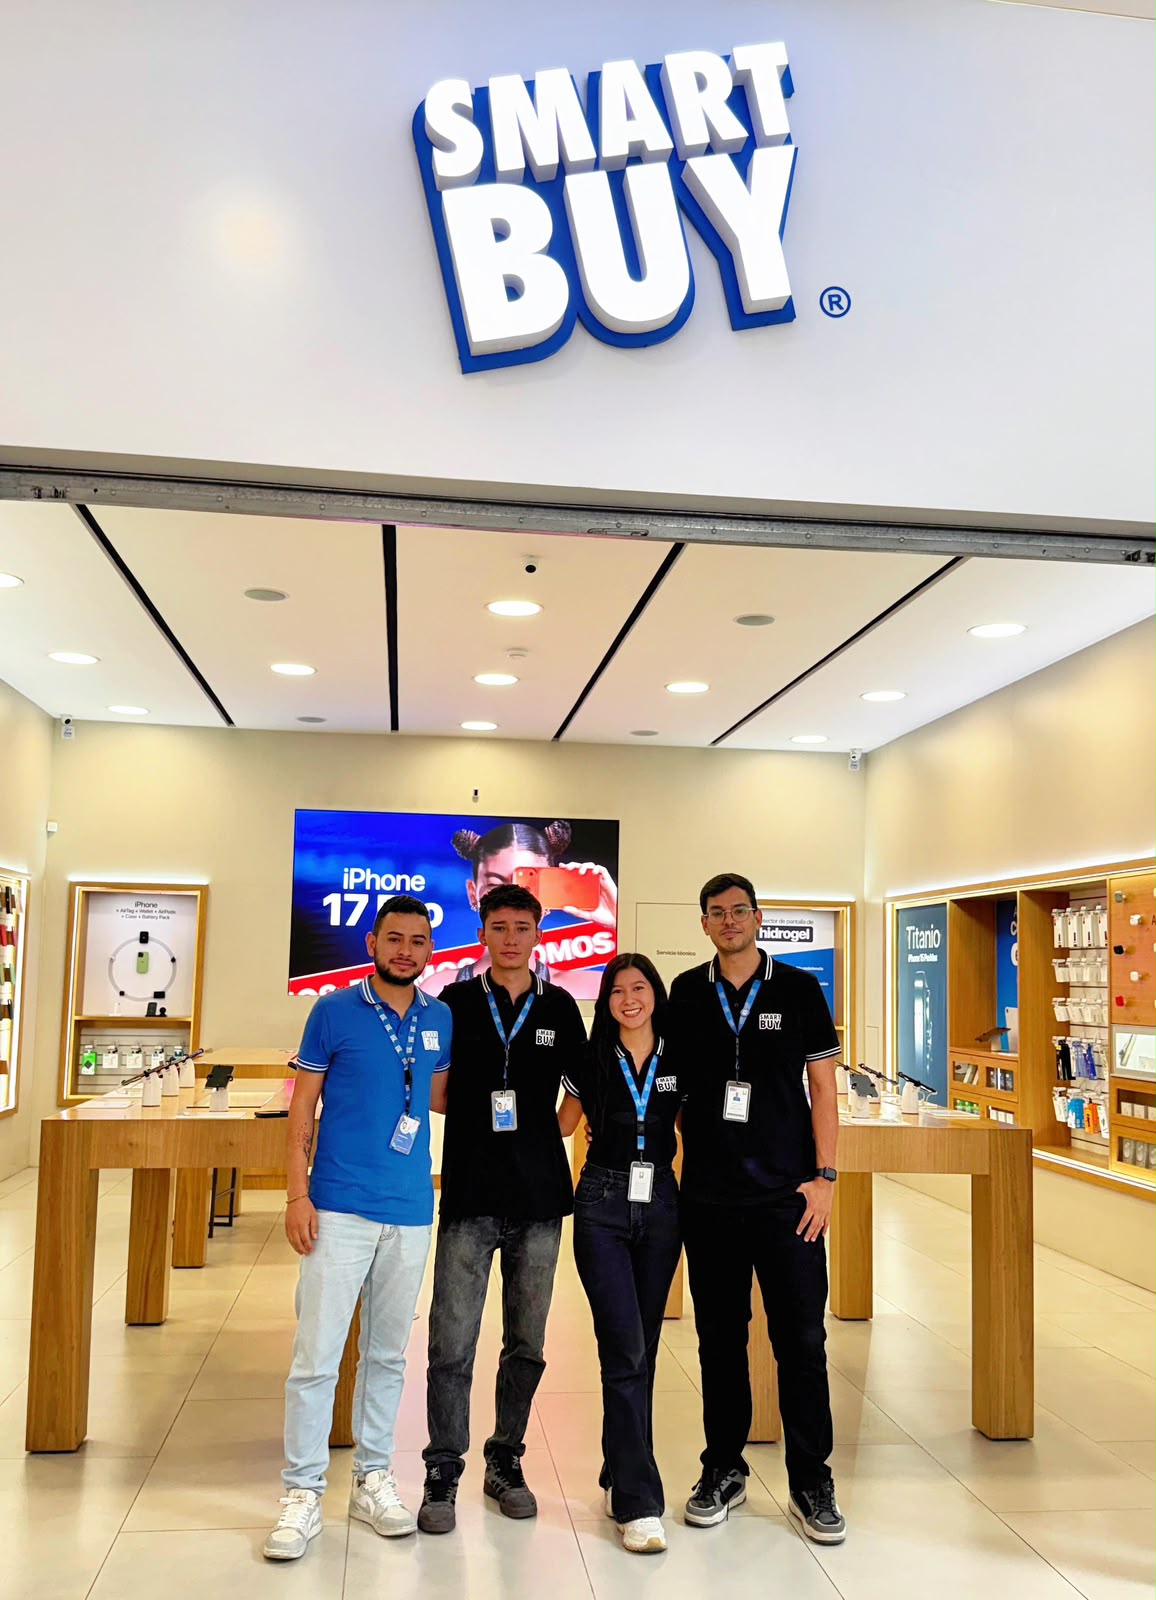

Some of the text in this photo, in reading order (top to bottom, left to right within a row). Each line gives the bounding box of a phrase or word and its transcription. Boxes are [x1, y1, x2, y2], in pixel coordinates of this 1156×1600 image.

[424, 41, 794, 190] SMART
[442, 145, 796, 356] BUY
[342, 867, 427, 892] iPhone
[134, 901, 158, 909] iPhone
[322, 892, 369, 927] 17
[759, 926, 810, 942] hidrogel
[905, 923, 941, 950] Titanio
[532, 931, 616, 965] OMOS
[759, 1019, 782, 1030] BUY
[536, 1035, 555, 1046] BUY
[657, 1082, 677, 1091] BUY
